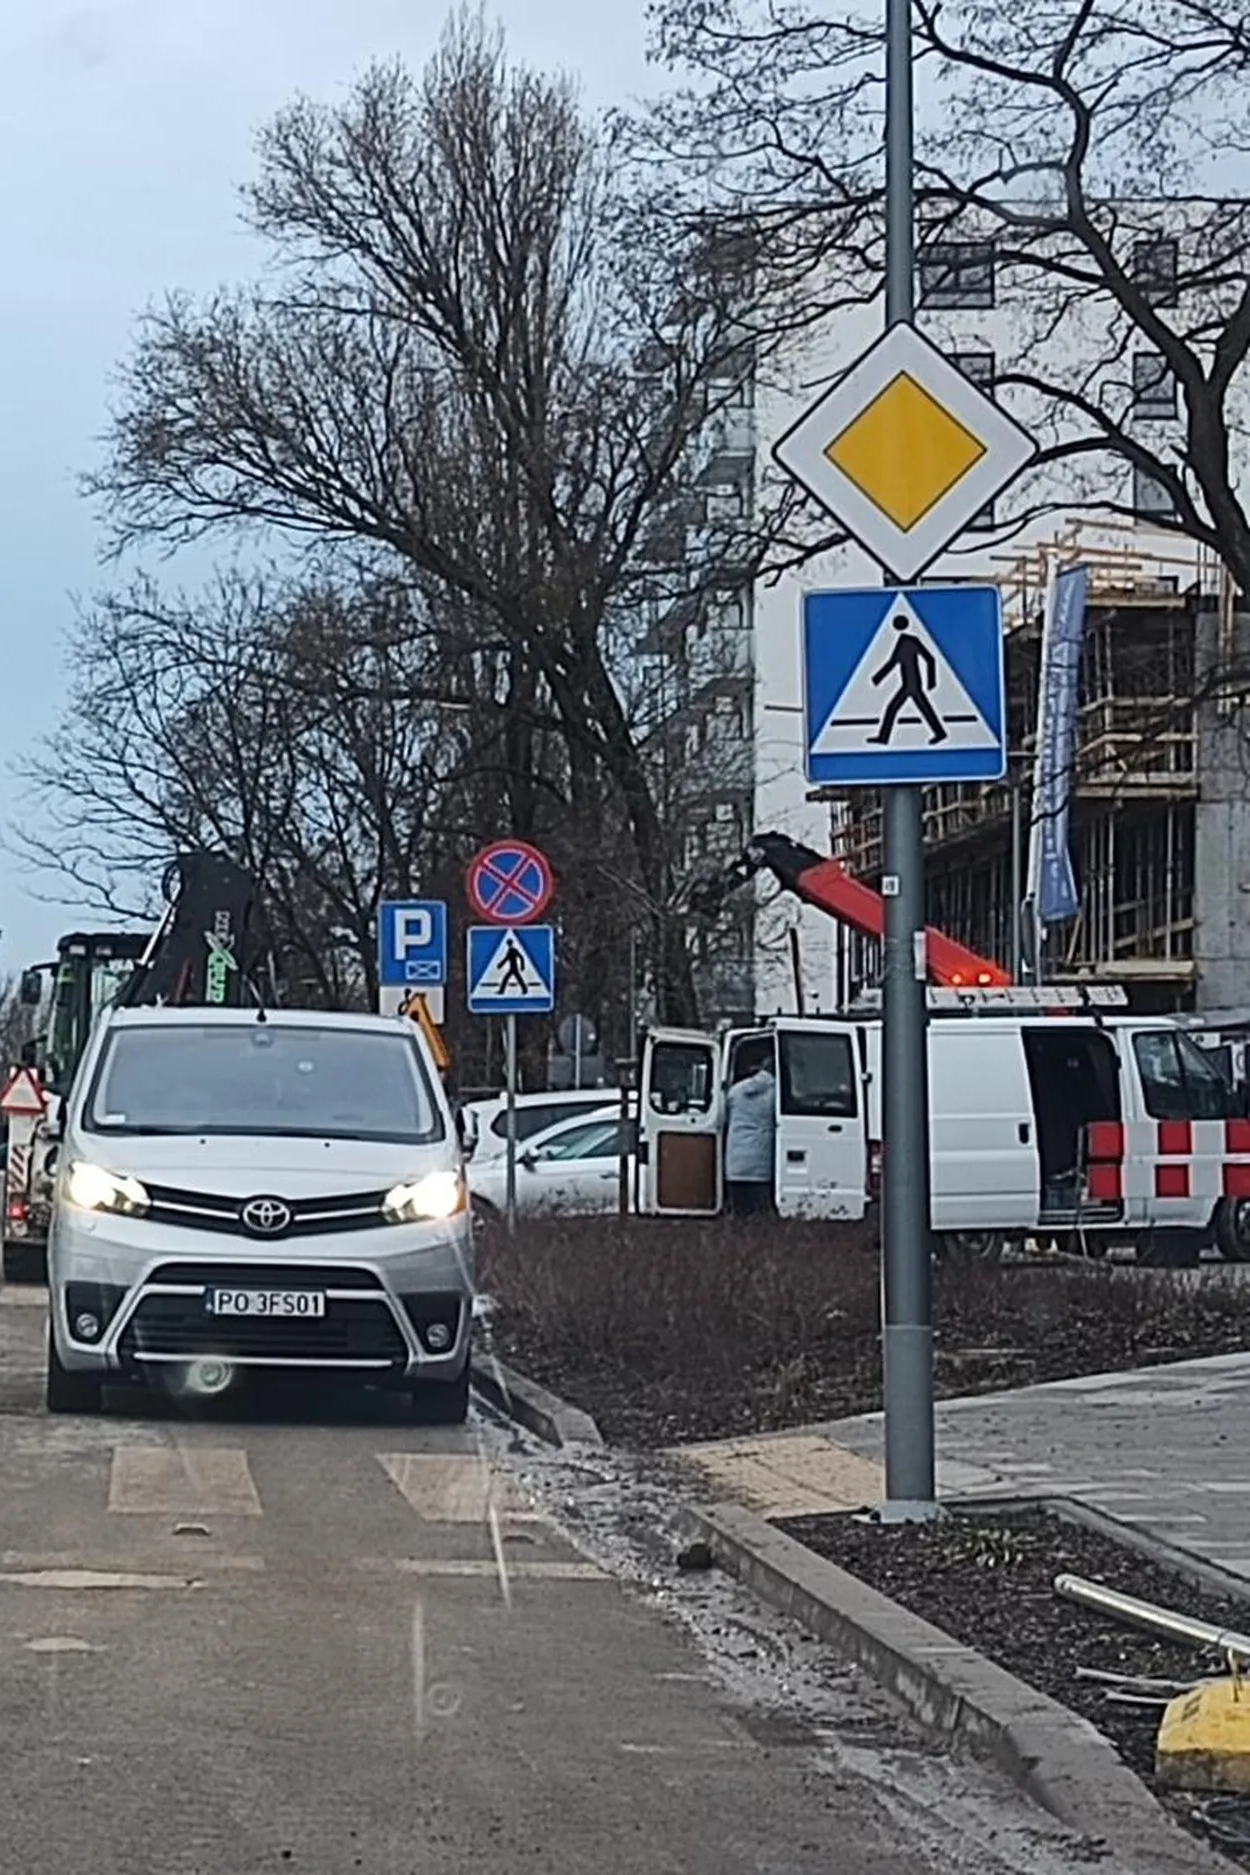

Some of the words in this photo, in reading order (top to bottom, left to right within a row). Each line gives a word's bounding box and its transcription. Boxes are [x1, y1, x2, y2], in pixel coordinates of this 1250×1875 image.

[394, 909, 432, 960] P
[219, 1292, 249, 1312] PO
[256, 1292, 320, 1314] 3FS01
